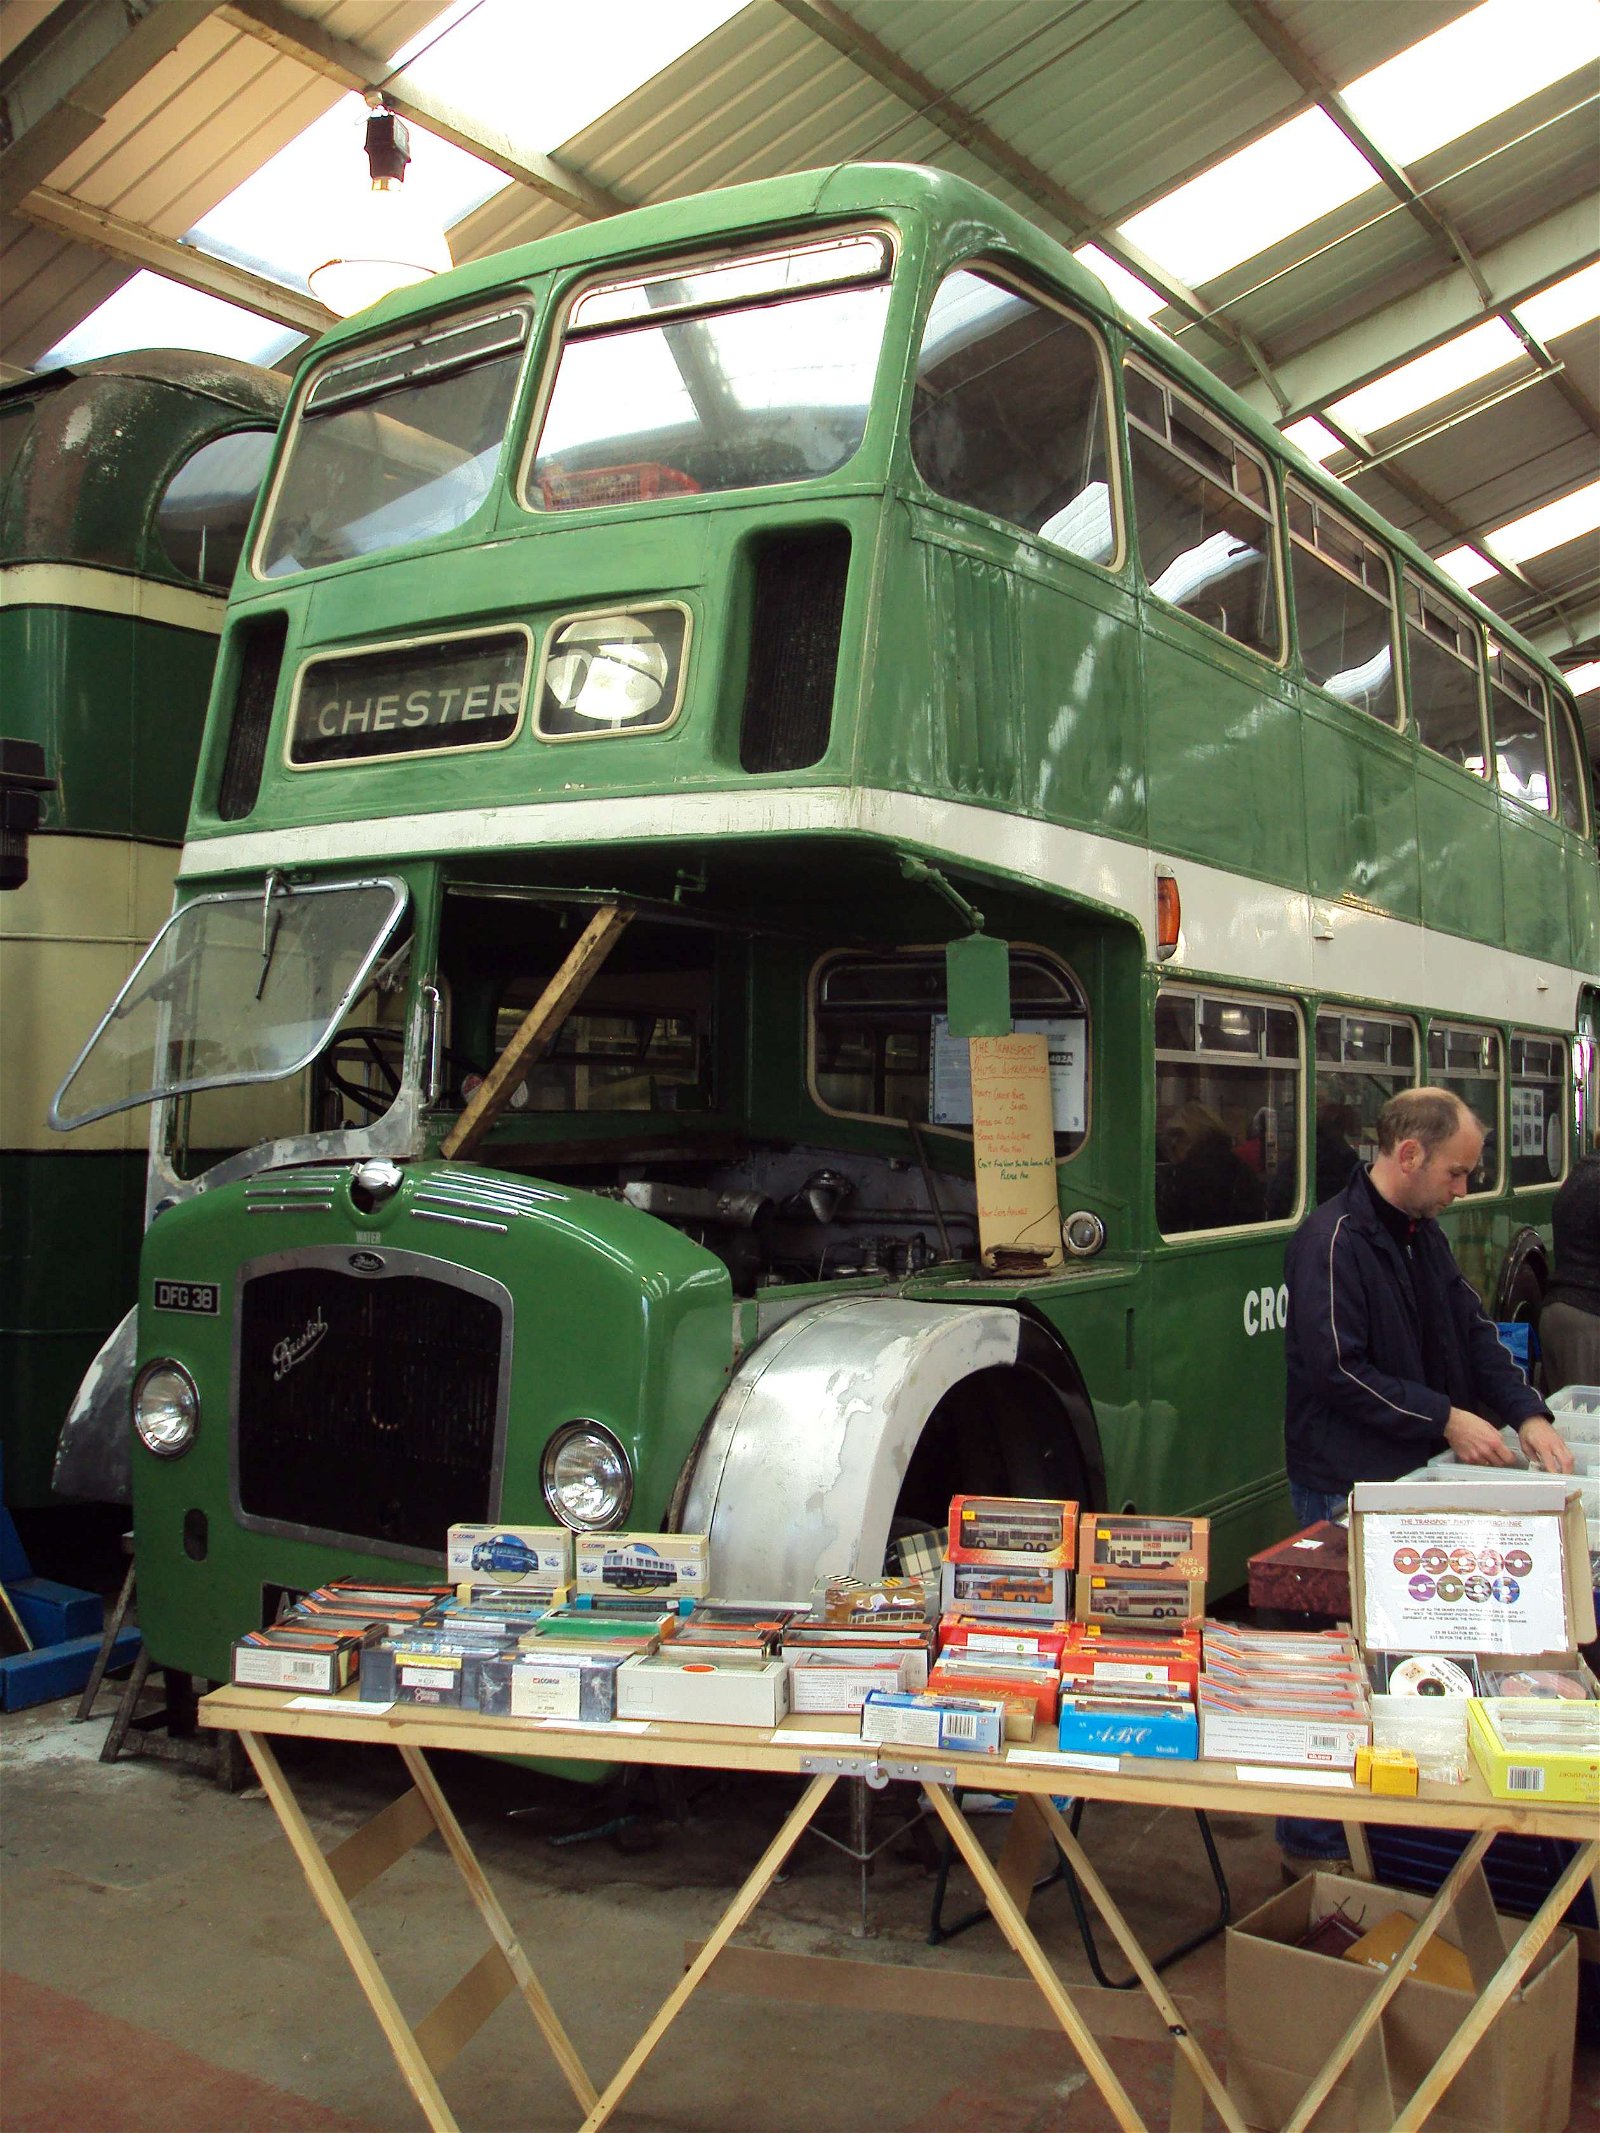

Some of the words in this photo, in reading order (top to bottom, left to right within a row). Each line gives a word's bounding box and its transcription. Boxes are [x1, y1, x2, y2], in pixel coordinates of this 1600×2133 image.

[318, 682, 523, 736] CHESTER
[356, 1232, 381, 1244] WATER
[159, 1286, 188, 1307] DFG
[192, 1288, 212, 1310] 38
[1088, 1725, 1152, 1744] ABC
